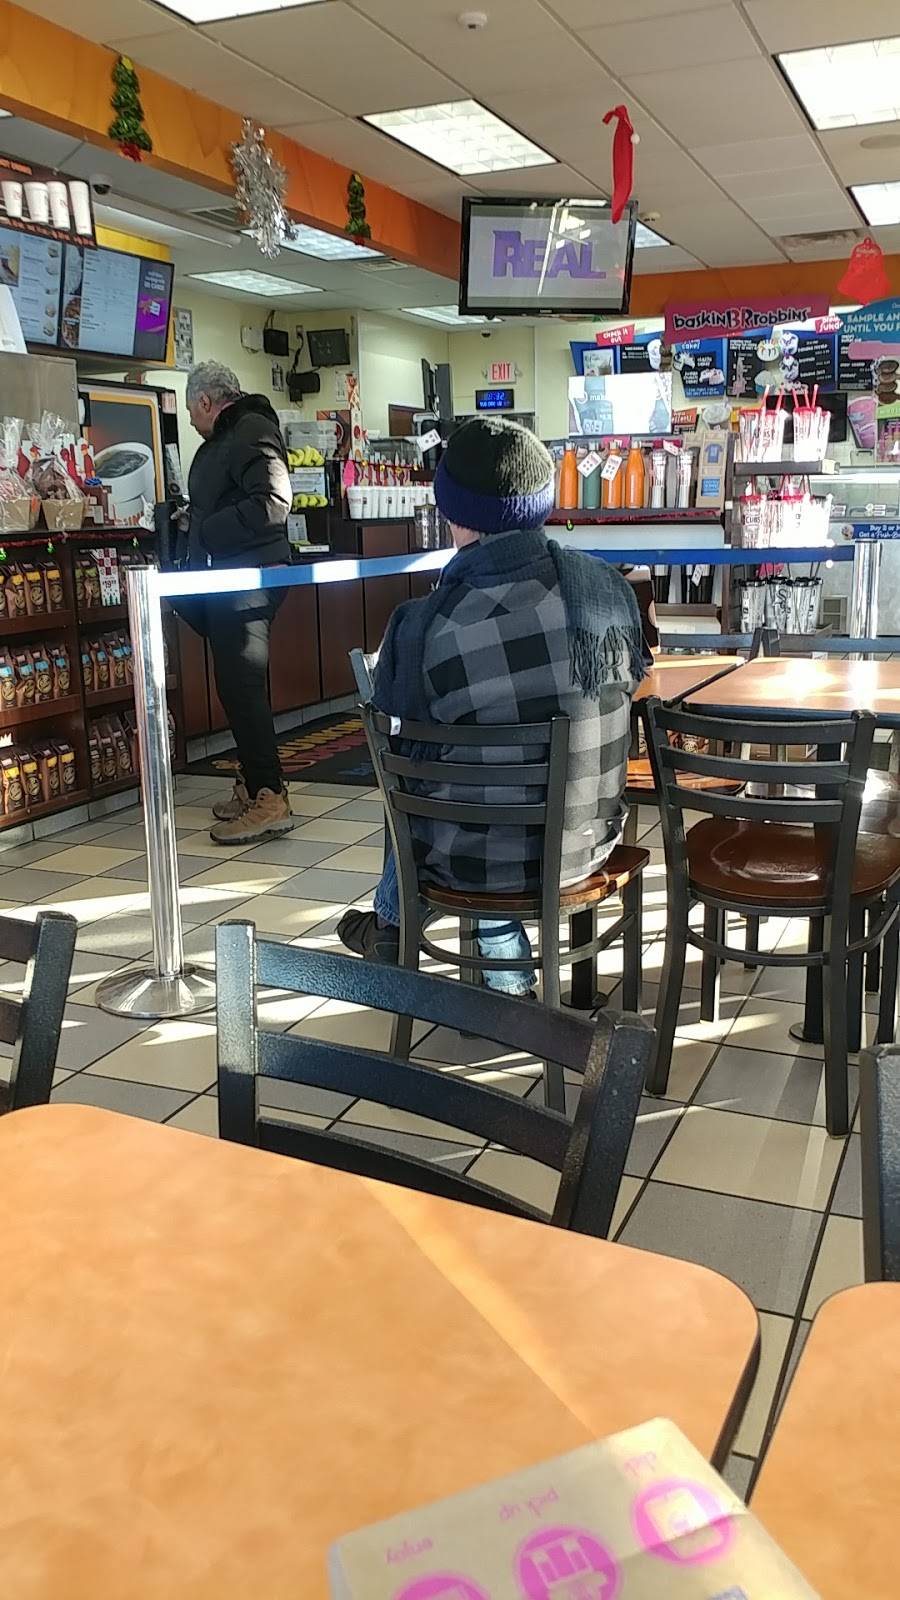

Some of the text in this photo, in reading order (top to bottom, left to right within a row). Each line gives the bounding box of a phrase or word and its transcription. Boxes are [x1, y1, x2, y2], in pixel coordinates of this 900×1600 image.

[493, 230, 606, 279] REAL
[674, 311, 725, 329] baskin
[753, 307, 810, 326] robbins
[847, 312, 884, 324] SAMPLE
[885, 311, 900, 322] AN
[844, 323, 872, 334] UNTIL
[873, 322, 894, 333] YOU
[492, 363, 511, 381] EXIT
[745, 515, 761, 524] CUBS
